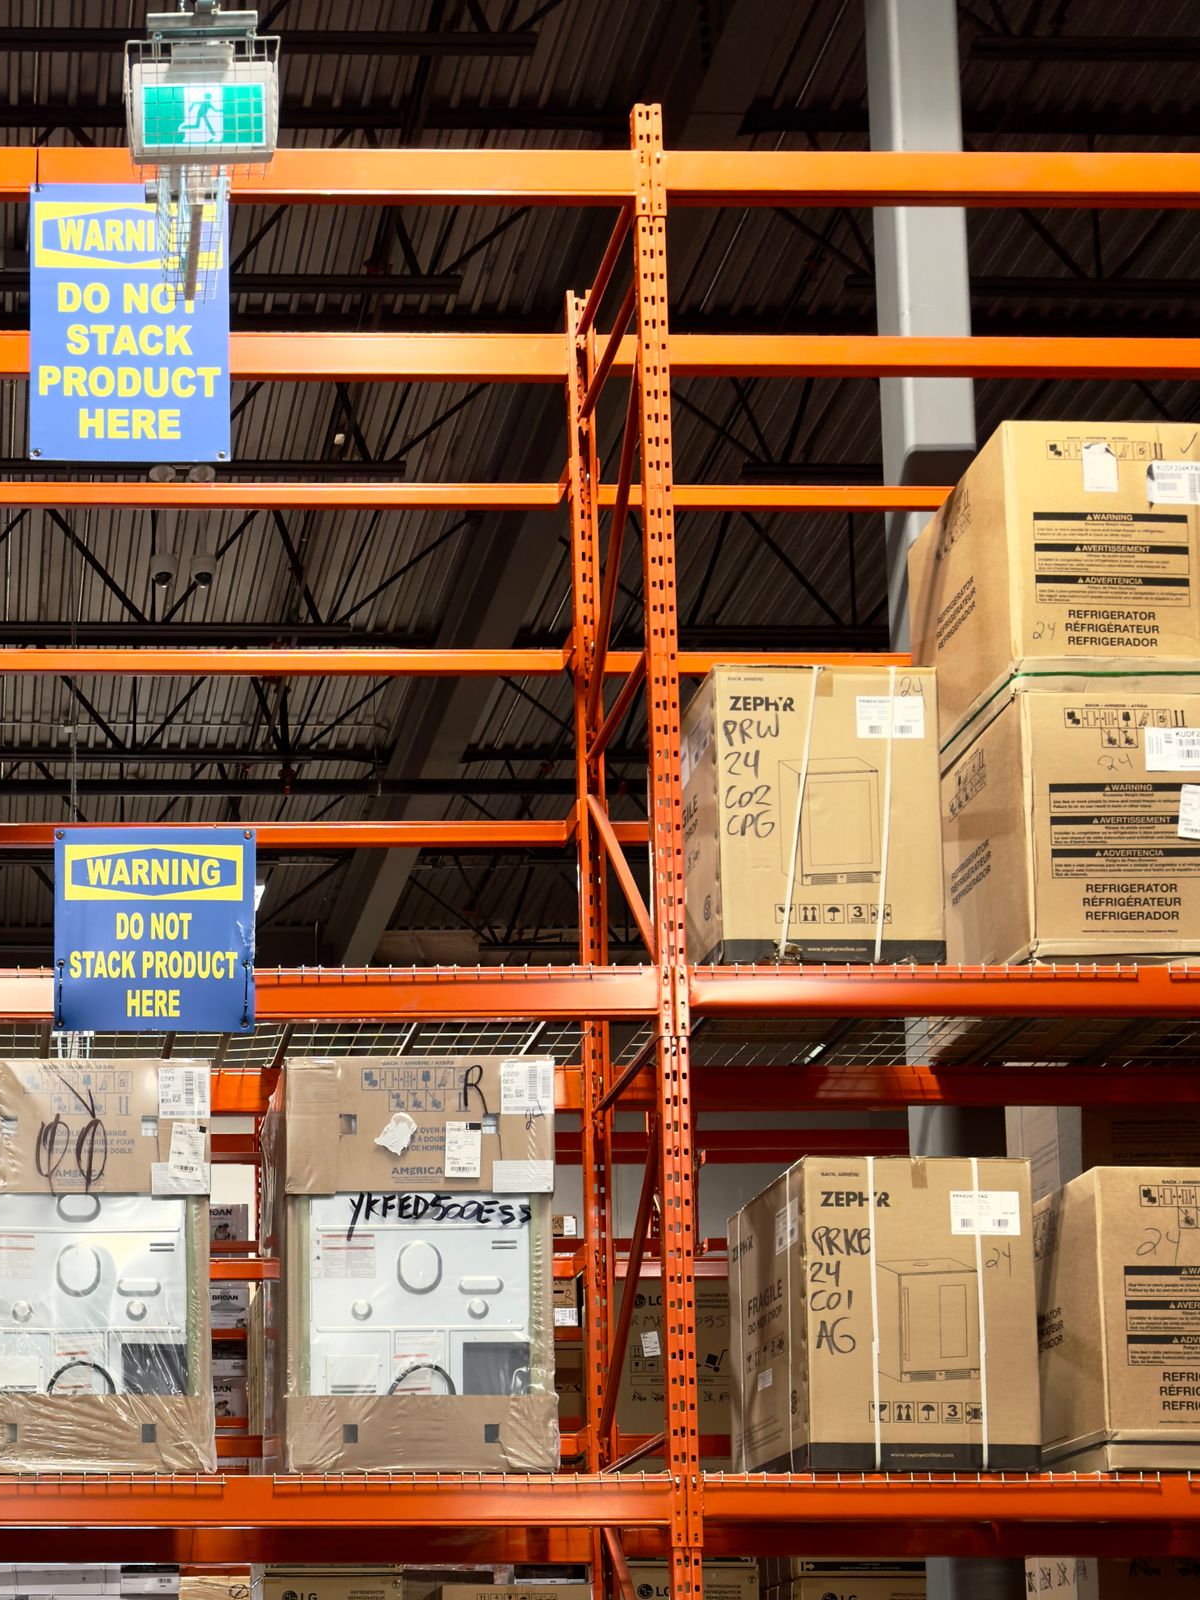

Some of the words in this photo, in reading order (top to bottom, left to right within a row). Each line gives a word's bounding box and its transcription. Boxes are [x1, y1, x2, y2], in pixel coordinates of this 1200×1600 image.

[58, 282, 110, 313] DO
[123, 283, 203, 314] NOT
[66, 324, 193, 356] STACK
[39, 366, 221, 397] PRODUCT
[79, 409, 181, 439] HERE
[1082, 545, 1151, 553] AVERTISSEMENT
[1085, 576, 1143, 585] ADVERTENCIA
[1065, 621, 1160, 634] RÉFRIGÉRATEUR
[1068, 610, 1156, 621] REFRIGERATOR
[1068, 636, 1158, 647] REFRIGERADOR
[730, 696, 795, 711] ZEPHYR
[722, 714, 780, 746] PRW
[724, 749, 760, 779] 24
[727, 810, 775, 838] CPG
[86, 857, 221, 887] WARNING
[1083, 895, 1182, 907] RÉFRIGÉRATEUR
[1085, 883, 1178, 893] REFRIGERATOR
[116, 912, 145, 941] DO
[150, 912, 192, 940] NOT
[1085, 911, 1179, 921] REFRIGERADOR
[69, 951, 136, 979] STACK
[141, 951, 238, 979] PRODUCT
[126, 989, 181, 1017] HERE
[464, 1065, 488, 1114] R
[392, 1167, 443, 1175] AMERICA
[812, 1226, 871, 1255] PRKB
[1136, 1228, 1181, 1266] 24
[810, 1261, 840, 1287] 24
[748, 1280, 783, 1318] FRAGILE
[816, 1317, 856, 1355] AG
